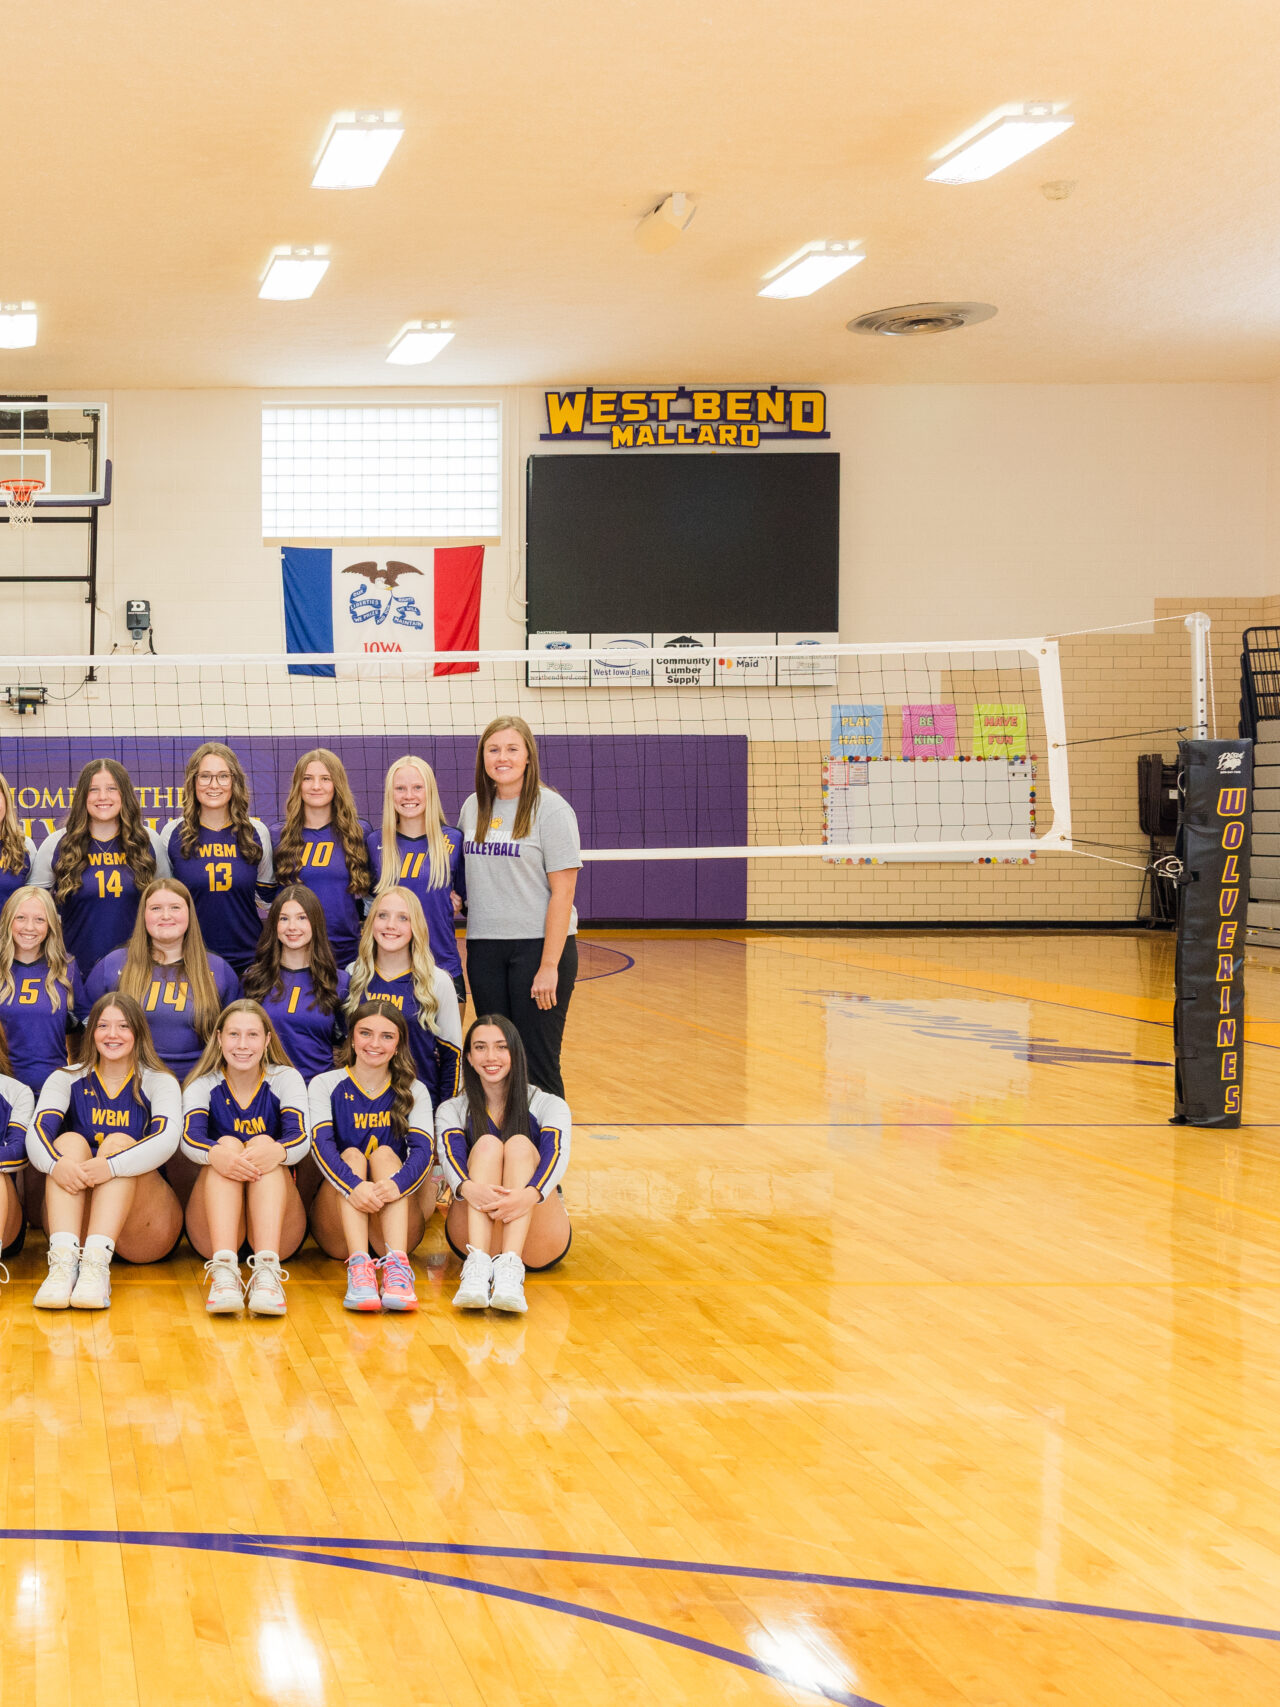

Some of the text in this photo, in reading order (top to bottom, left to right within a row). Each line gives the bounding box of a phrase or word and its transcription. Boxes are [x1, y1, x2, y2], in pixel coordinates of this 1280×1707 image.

[546, 390, 826, 435] WEST BEND
[611, 423, 760, 449] MALLARD
[363, 641, 403, 653] IOWA
[656, 658, 711, 667] Community
[665, 666, 702, 675] Lumber
[736, 660, 759, 668] Maid
[593, 668, 650, 676] West Iowa Bank
[667, 675, 701, 685] Supply
[841, 716, 872, 728] PLAY
[919, 716, 934, 727] BE
[984, 716, 1018, 727] HAVE
[838, 735, 874, 746] HARD
[913, 734, 944, 746] KIND
[988, 735, 1014, 745] FUN
[198, 843, 237, 858] WBM
[301, 841, 335, 867] 10
[464, 840, 521, 857] OLLEYBALL
[88, 852, 127, 866] WBM
[400, 852, 426, 879] 11
[94, 869, 124, 898] 14
[204, 862, 233, 892] 13
[1216, 787, 1247, 1115] WOLVERINES
[18, 978, 41, 1004] 5
[145, 981, 189, 1012] 14
[287, 986, 301, 1014] 1
[91, 1107, 130, 1127] WBM
[353, 1111, 391, 1129] WBM
[233, 1116, 267, 1135] WBM
